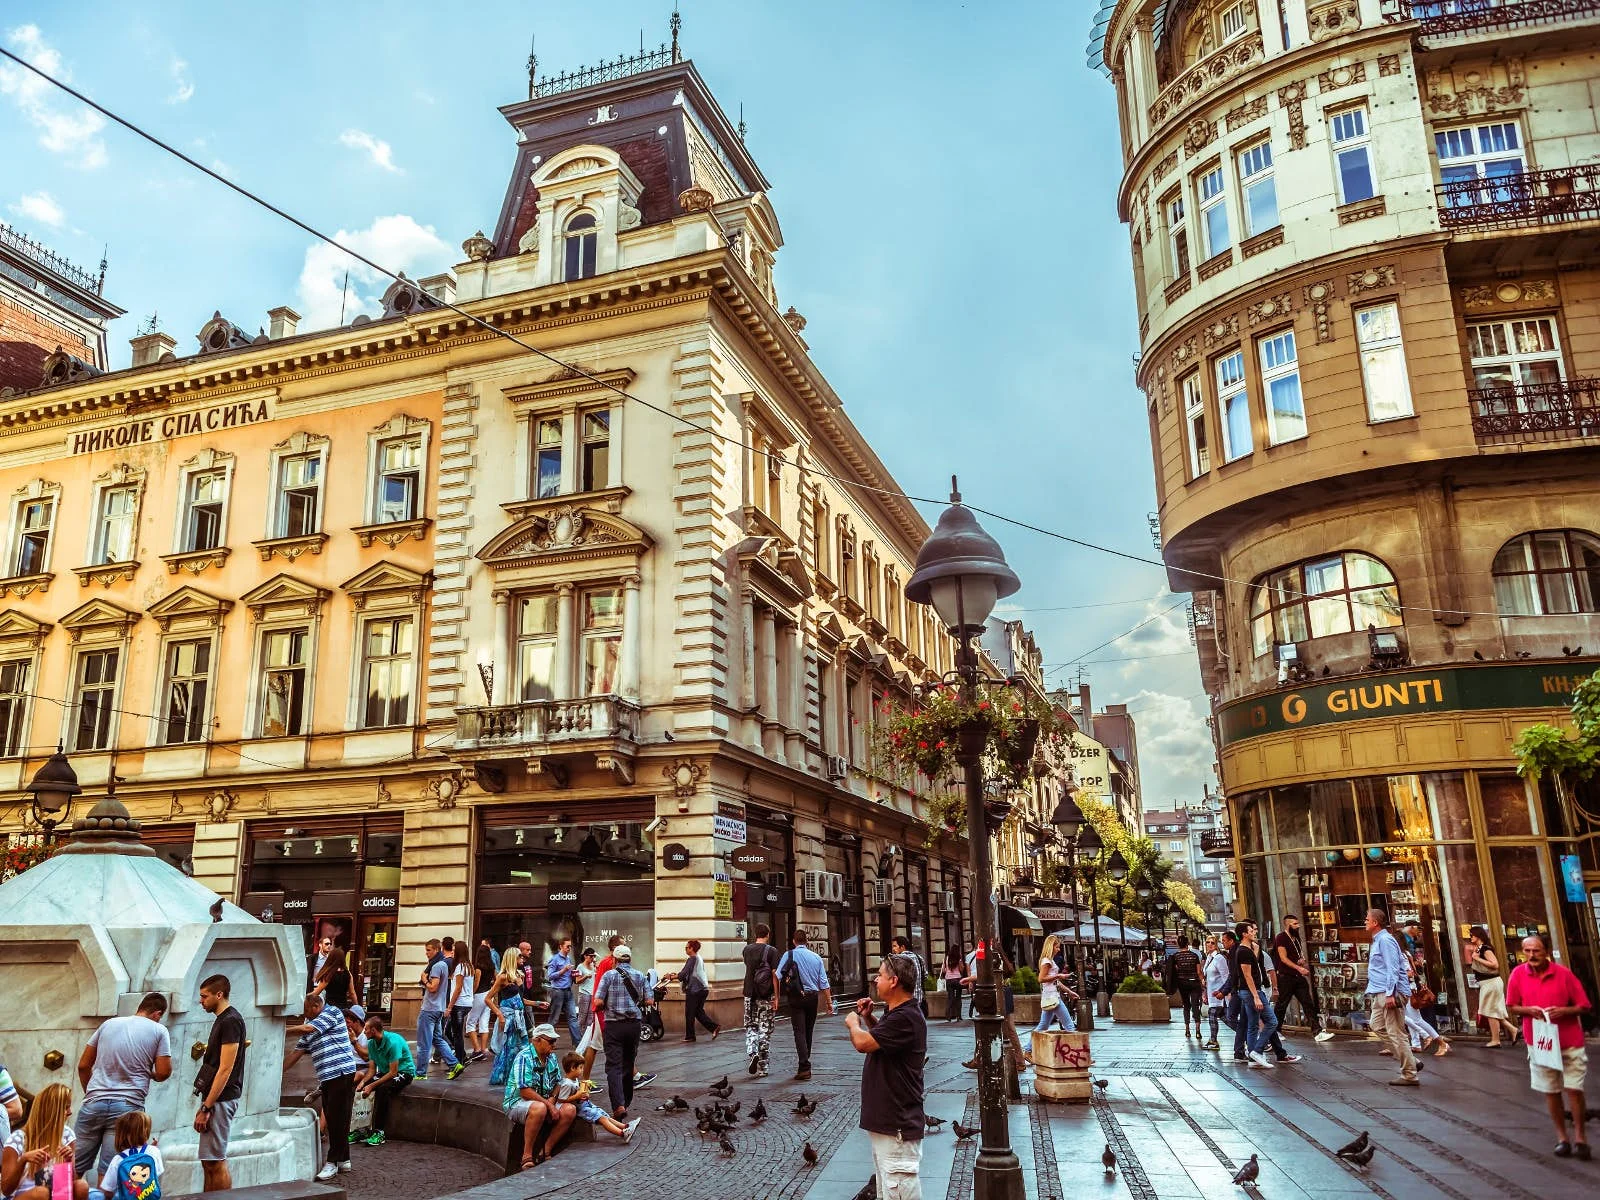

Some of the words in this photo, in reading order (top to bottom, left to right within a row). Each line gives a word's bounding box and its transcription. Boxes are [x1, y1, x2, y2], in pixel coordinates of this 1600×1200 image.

[73, 421, 153, 454] НИКОЛЕ
[162, 399, 268, 437] СПАСИЋА
[1327, 679, 1443, 713] GIUNTI
[738, 855, 764, 863] adidas
[362, 896, 396, 907] adidas
[550, 892, 577, 901] adidas
[284, 899, 308, 909] adidas
